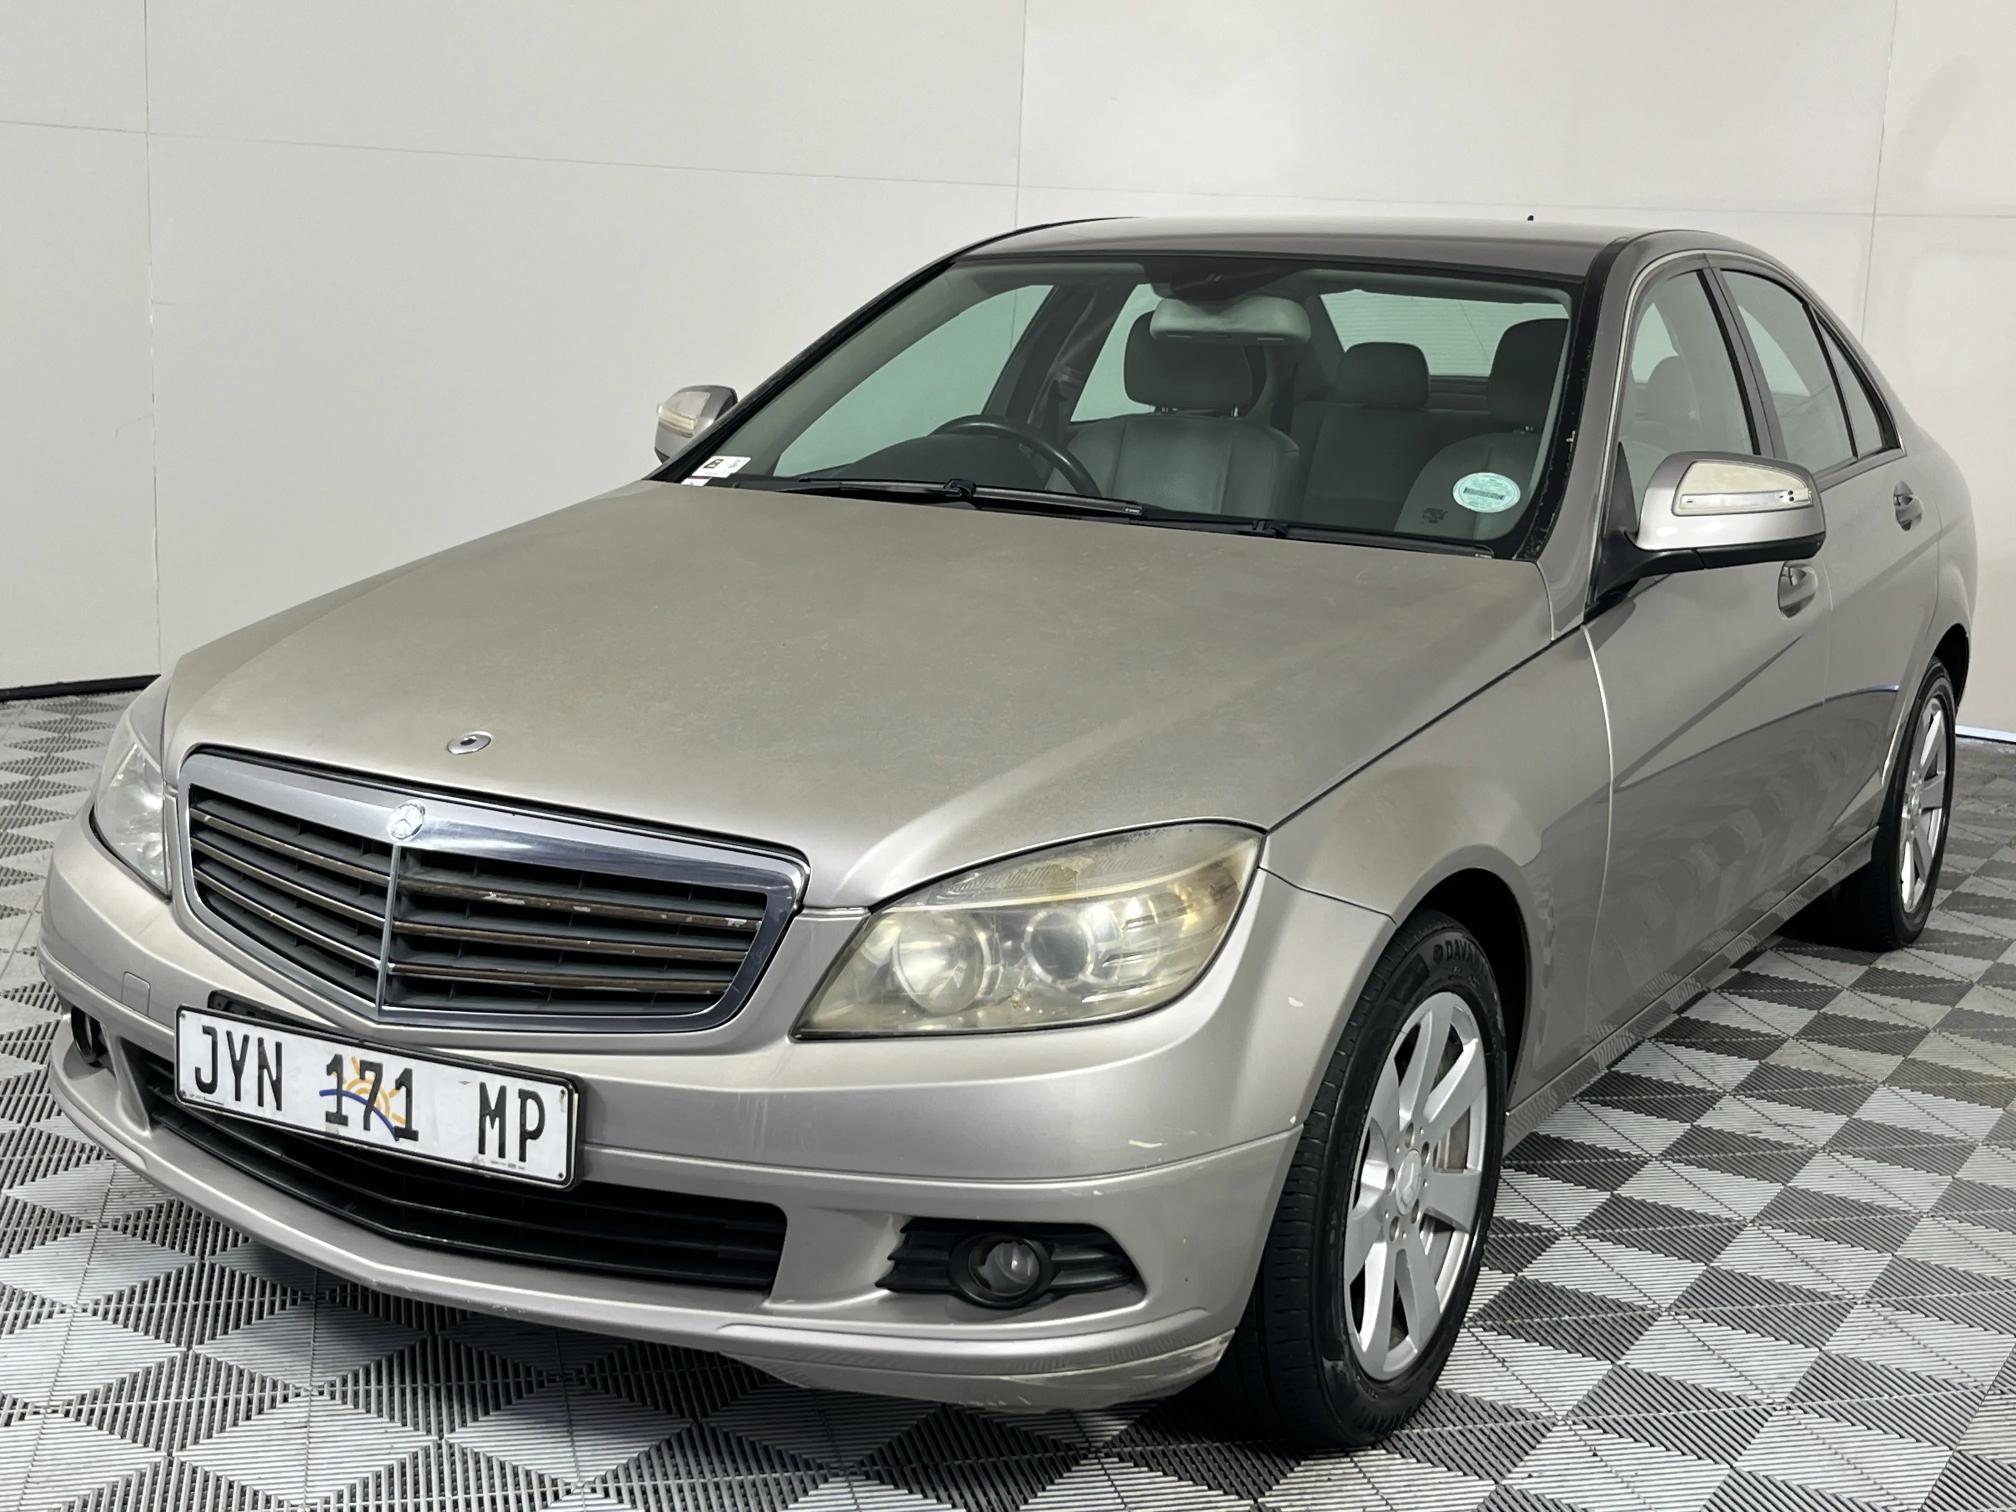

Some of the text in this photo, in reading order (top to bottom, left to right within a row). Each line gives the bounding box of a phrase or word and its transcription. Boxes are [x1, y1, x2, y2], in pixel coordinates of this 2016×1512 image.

[195, 1025, 546, 1162] JYN 171 MP
